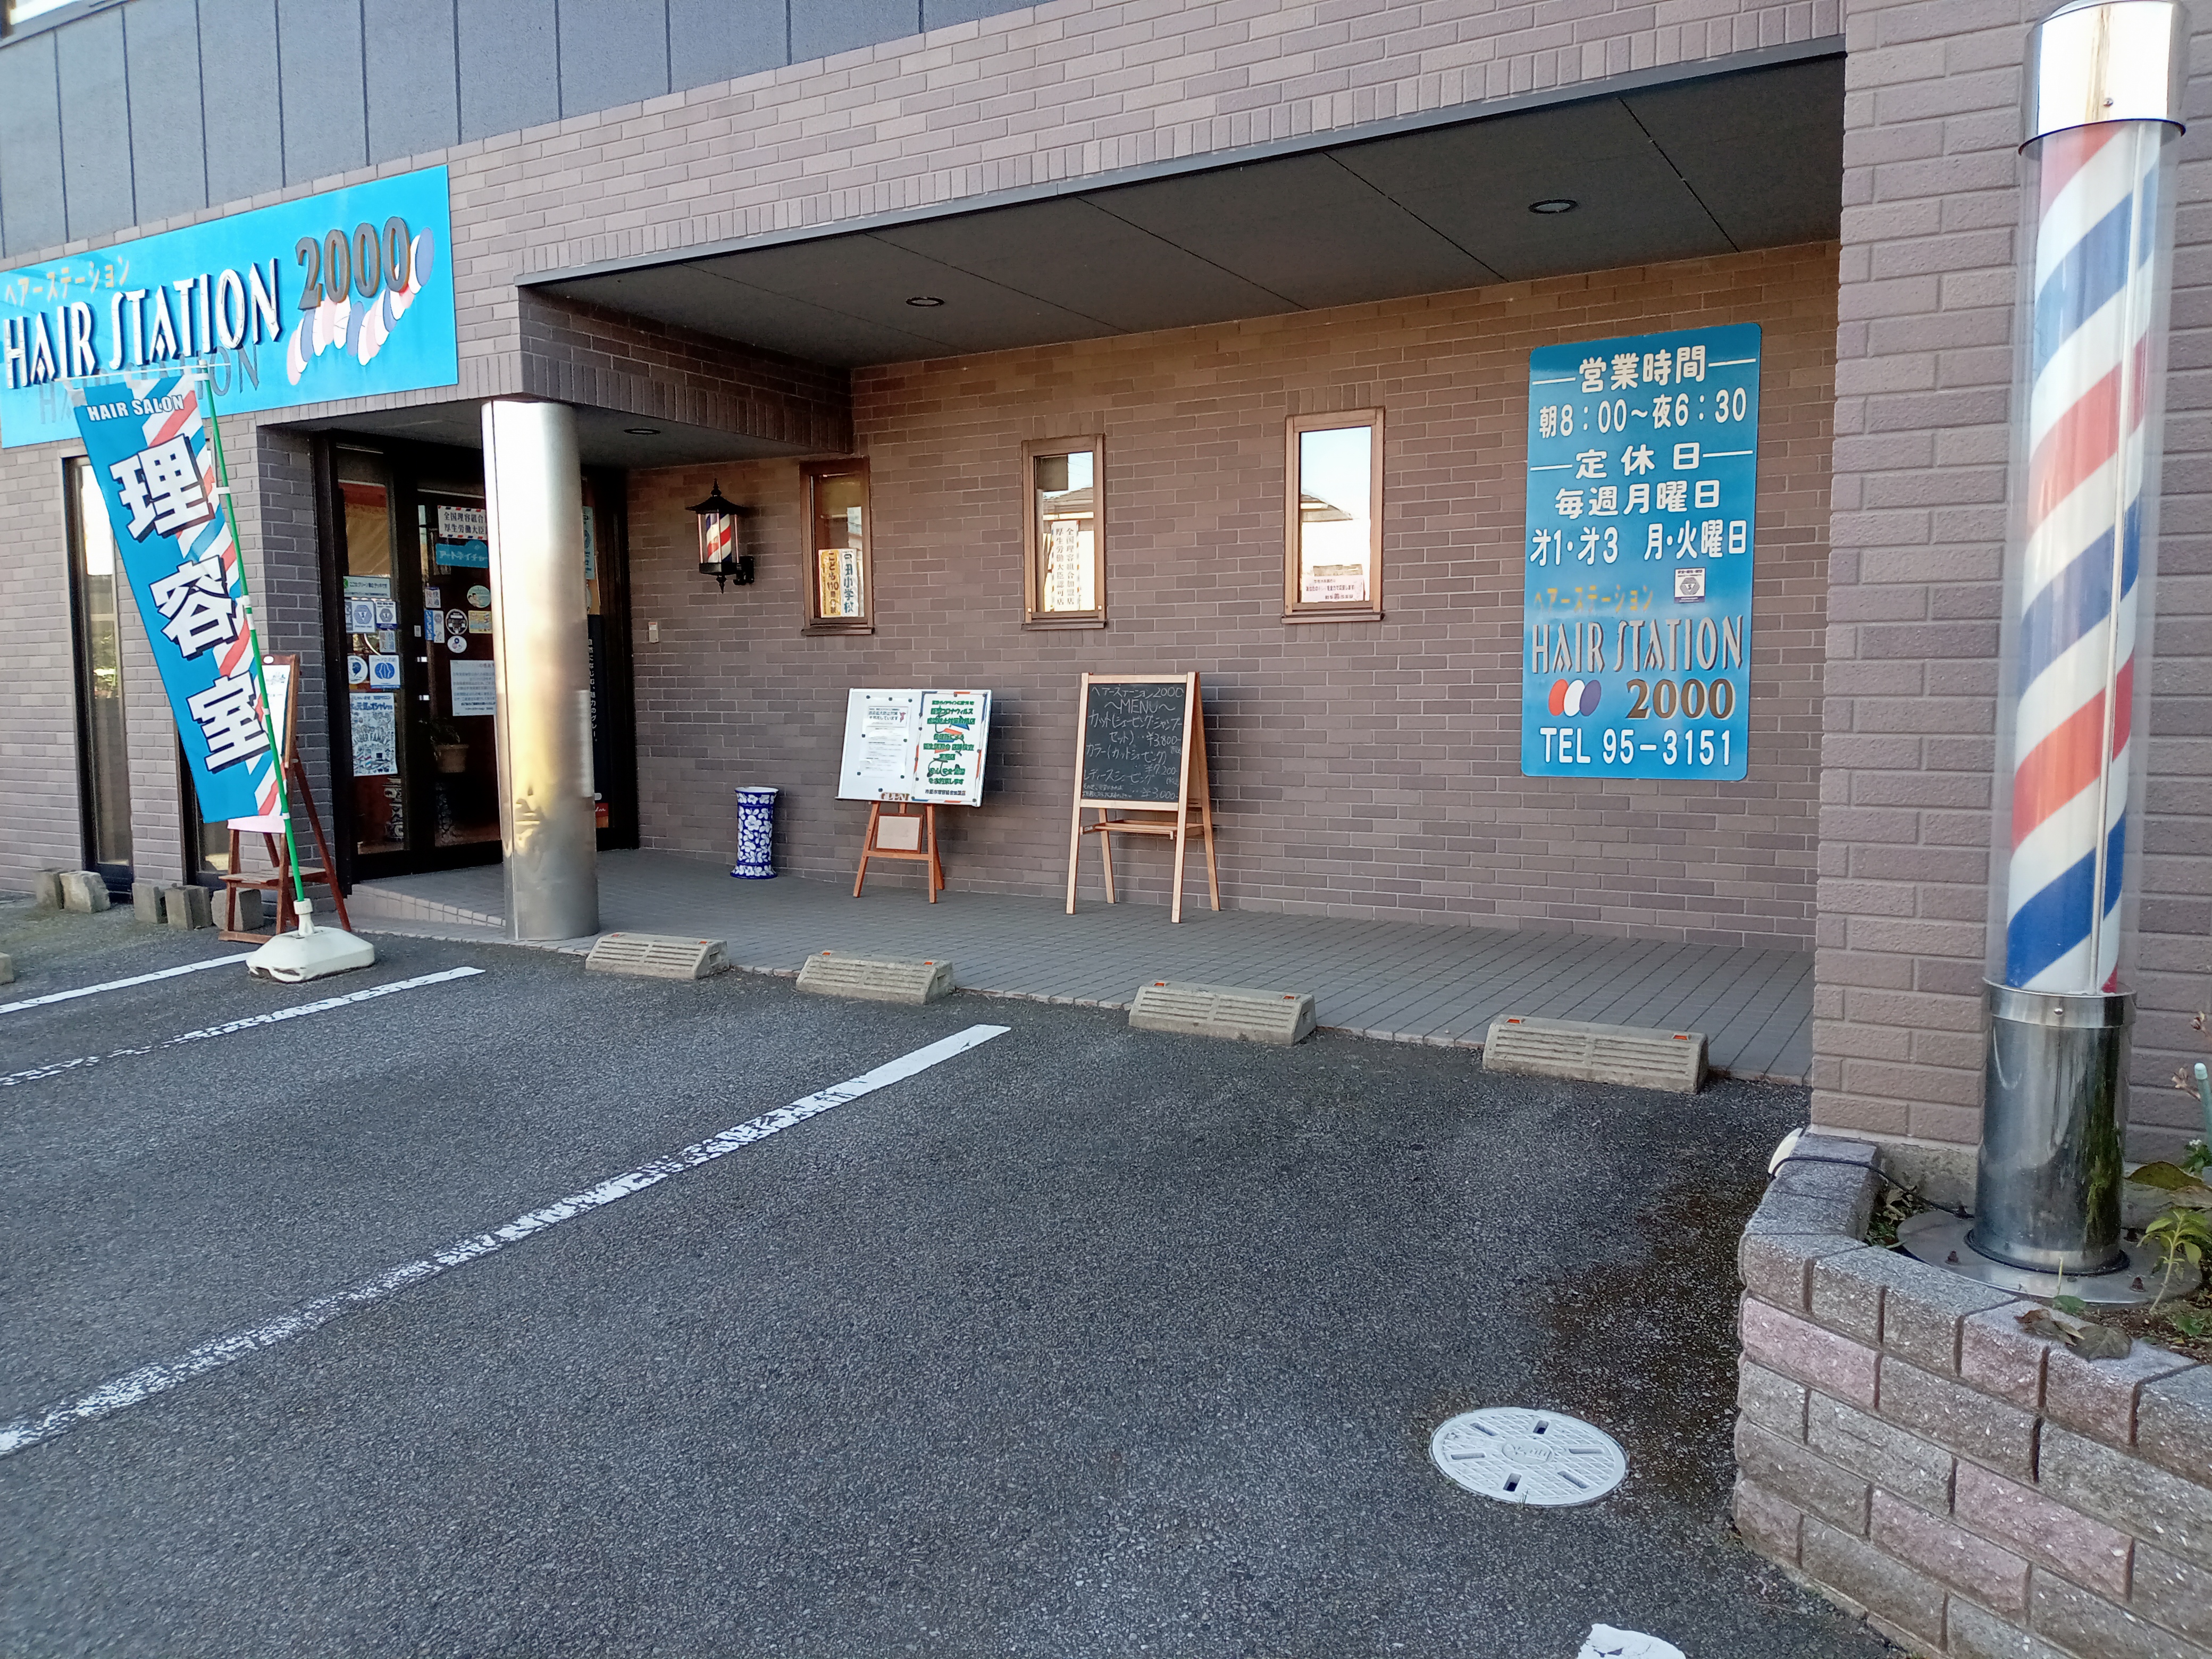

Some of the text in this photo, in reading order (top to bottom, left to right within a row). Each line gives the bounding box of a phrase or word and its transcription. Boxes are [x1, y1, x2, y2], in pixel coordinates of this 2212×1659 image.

[5, 255, 130, 307] ヘアーステーション
[4, 216, 410, 389] HAIR STATION 2000
[1579, 345, 1705, 393] 営業時間
[87, 395, 184, 422] HAIR SALON
[444, 512, 486, 524] 全国理容組合
[1555, 480, 1720, 520] 毎週月曜日
[445, 523, 487, 534] 厚生労働大臣
[109, 433, 271, 772] 理容室
[1534, 584, 1653, 614] ヘアーステーション
[1532, 615, 1743, 674] HAIR STATION
[1626, 678, 1736, 720] 2000
[1540, 727, 1730, 766] TEL 95-3151
